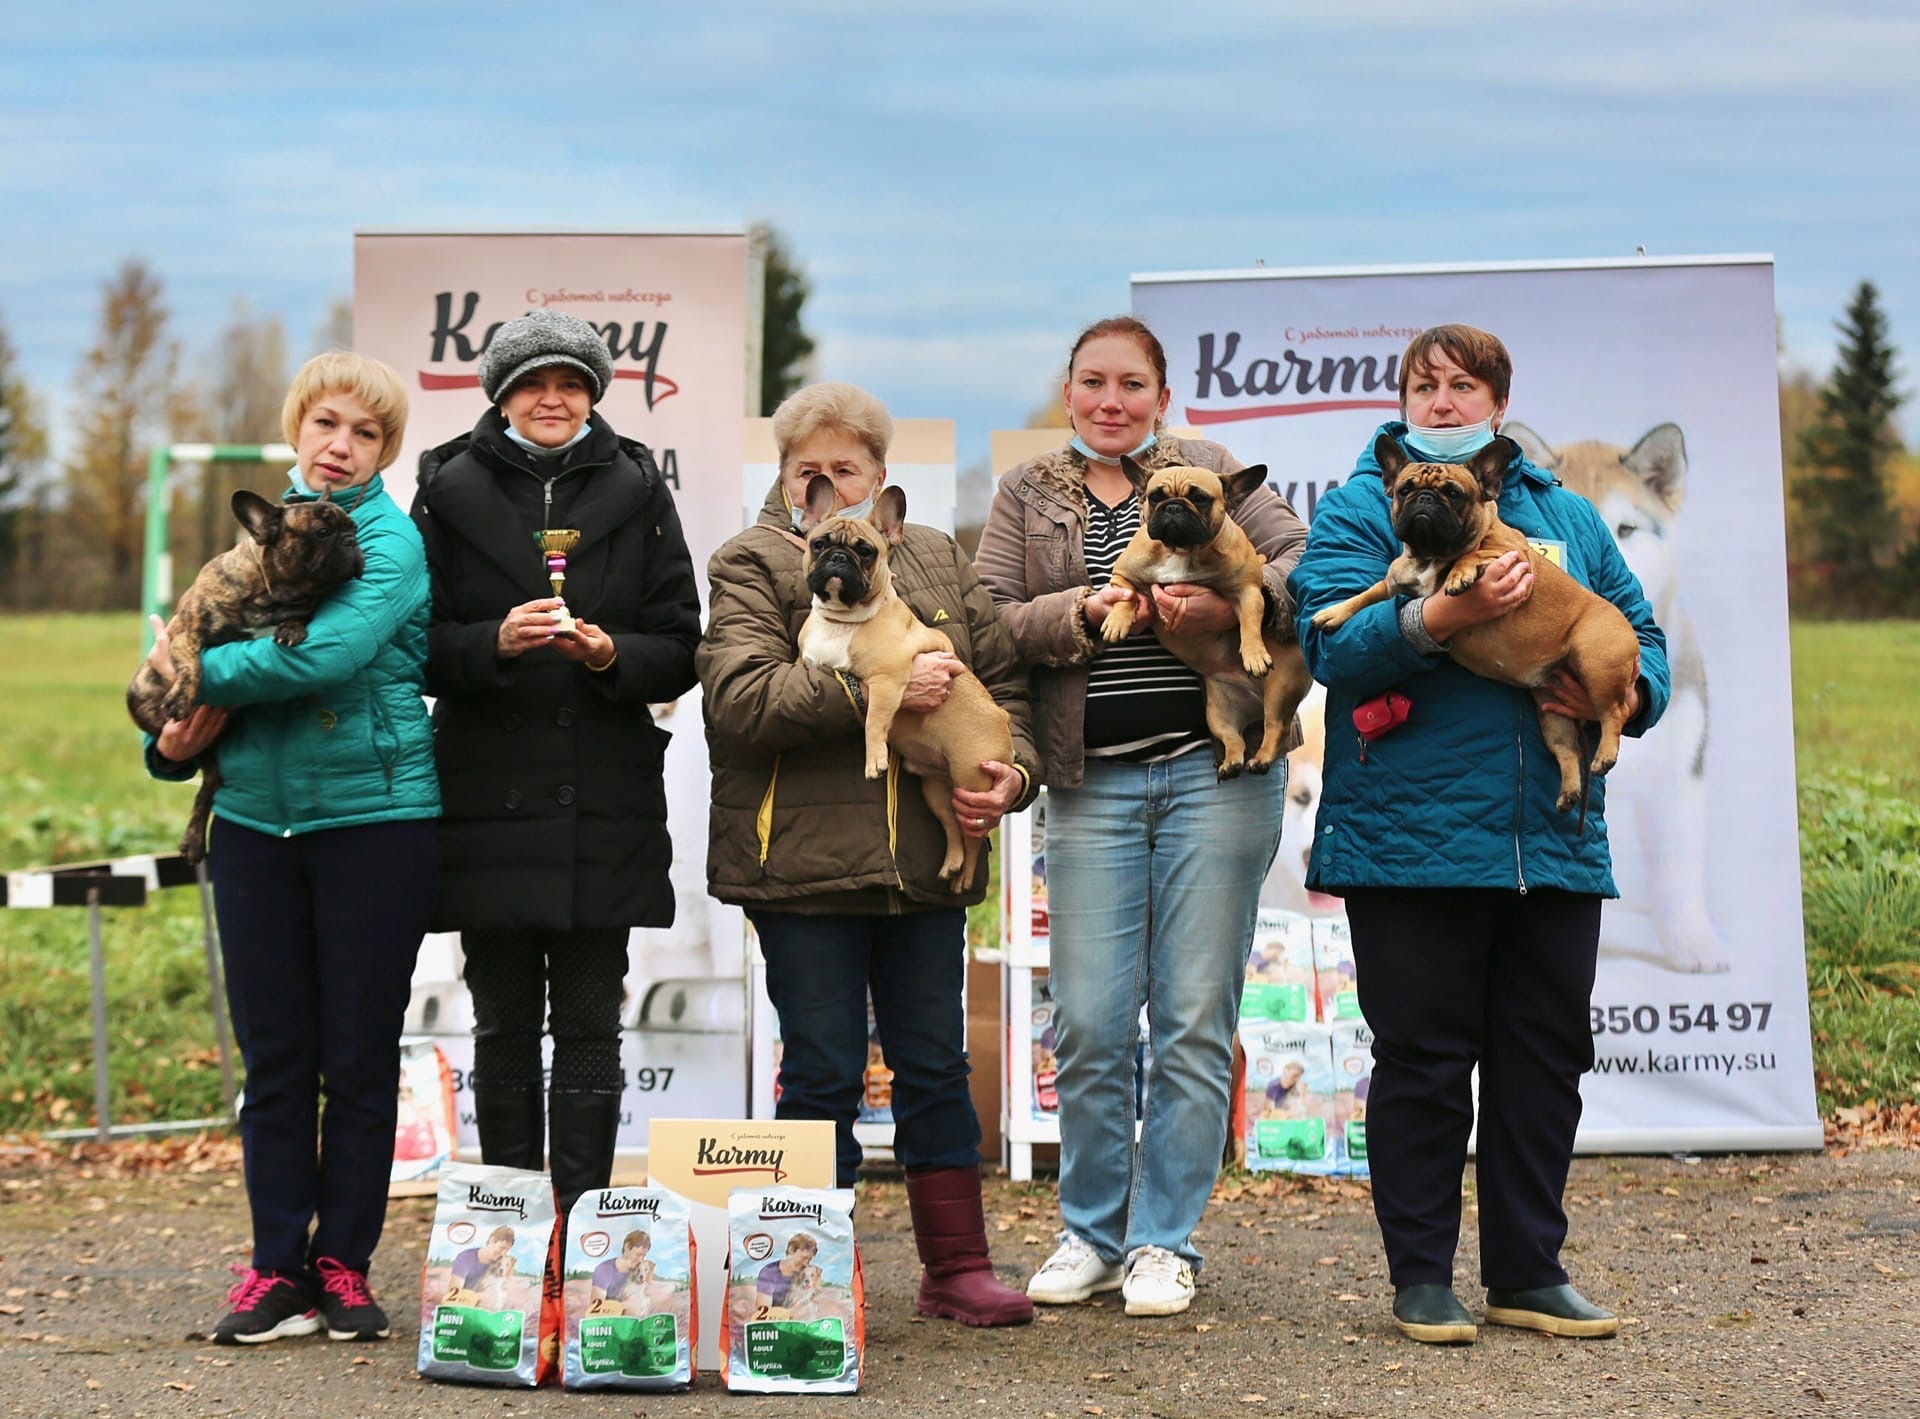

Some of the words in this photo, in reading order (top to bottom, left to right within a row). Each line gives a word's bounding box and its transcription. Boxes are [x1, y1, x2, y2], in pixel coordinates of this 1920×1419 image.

[429, 291, 668, 412] Kmy
[1668, 1003, 1719, 1033] 54
[1726, 1003, 1773, 1033] 97
[1592, 1049, 1776, 1076] ww.karmy.su
[637, 1067, 675, 1092] 97
[697, 1138, 784, 1184] Karmy
[468, 1184, 526, 1220] Karmy
[598, 1190, 661, 1222] Karmy
[761, 1196, 826, 1226] Karmy
[447, 1287, 460, 1302] 2
[590, 1298, 602, 1314] 2
[440, 1314, 464, 1325] MINI
[756, 1305, 769, 1320] 2
[585, 1326, 612, 1336] MINI
[751, 1330, 779, 1340] MINI
